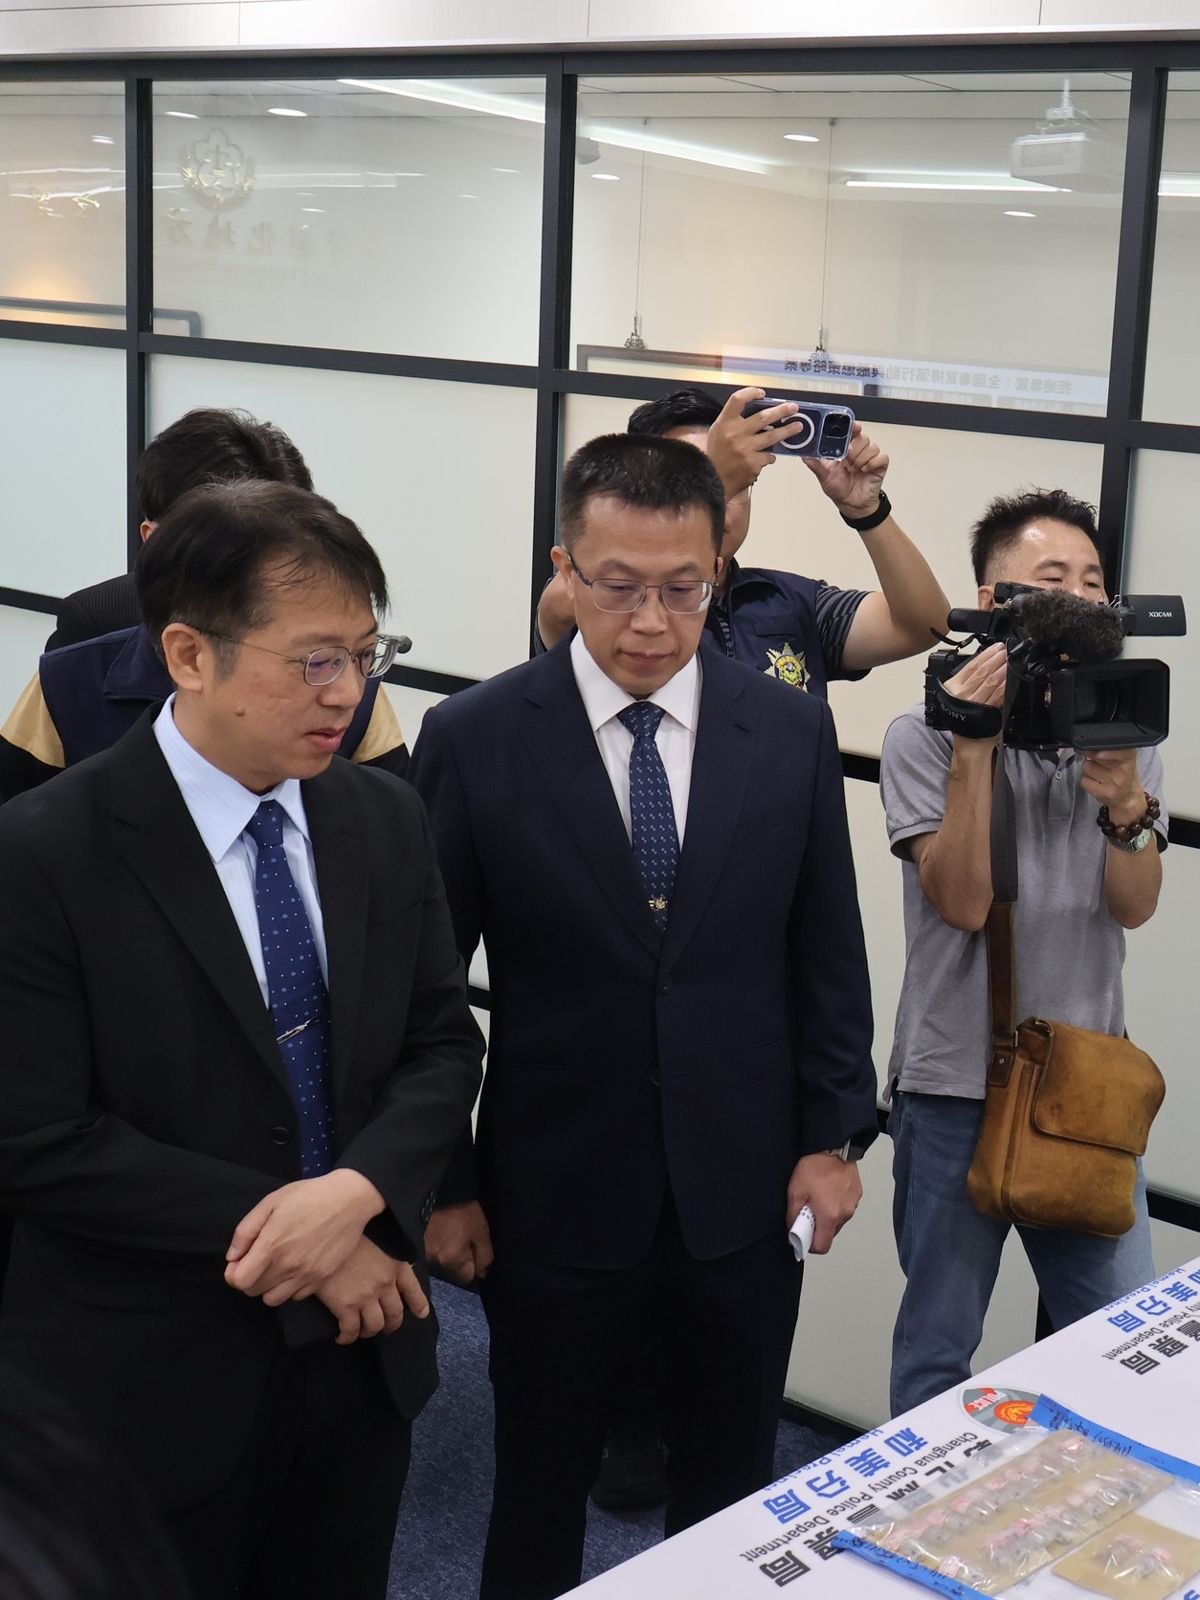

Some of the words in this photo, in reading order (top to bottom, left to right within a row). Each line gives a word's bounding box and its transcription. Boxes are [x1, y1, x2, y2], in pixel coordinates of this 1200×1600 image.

[943, 708, 967, 721] ONY
[1101, 1325, 1162, 1360] Department
[914, 1430, 977, 1468] Changhua
[763, 1427, 928, 1524] 和美分局
[870, 1463, 918, 1494] County
[827, 1491, 871, 1517] Police
[739, 1514, 829, 1563] Department
